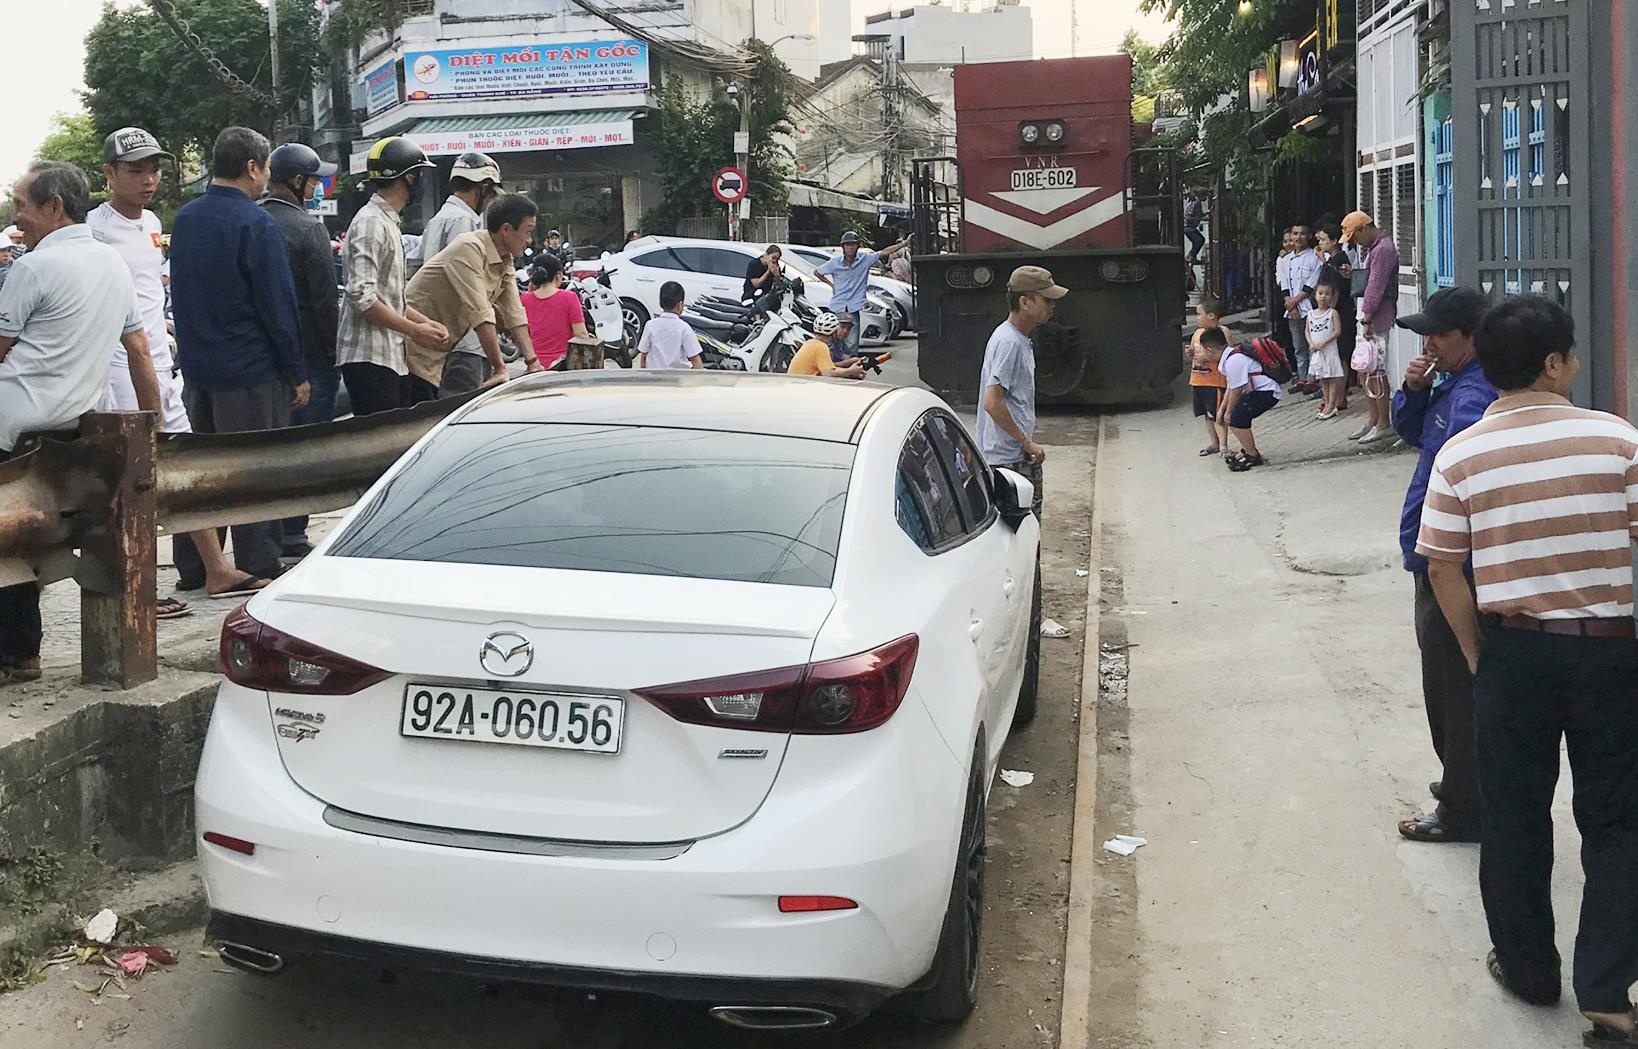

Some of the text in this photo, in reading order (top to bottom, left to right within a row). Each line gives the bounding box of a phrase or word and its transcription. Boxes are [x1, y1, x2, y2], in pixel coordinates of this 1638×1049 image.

[449, 41, 640, 69] DIỆT MỐI TẬN GỐC
[1013, 170, 1074, 188] D18E-602
[410, 690, 612, 746] 92A-060.56
